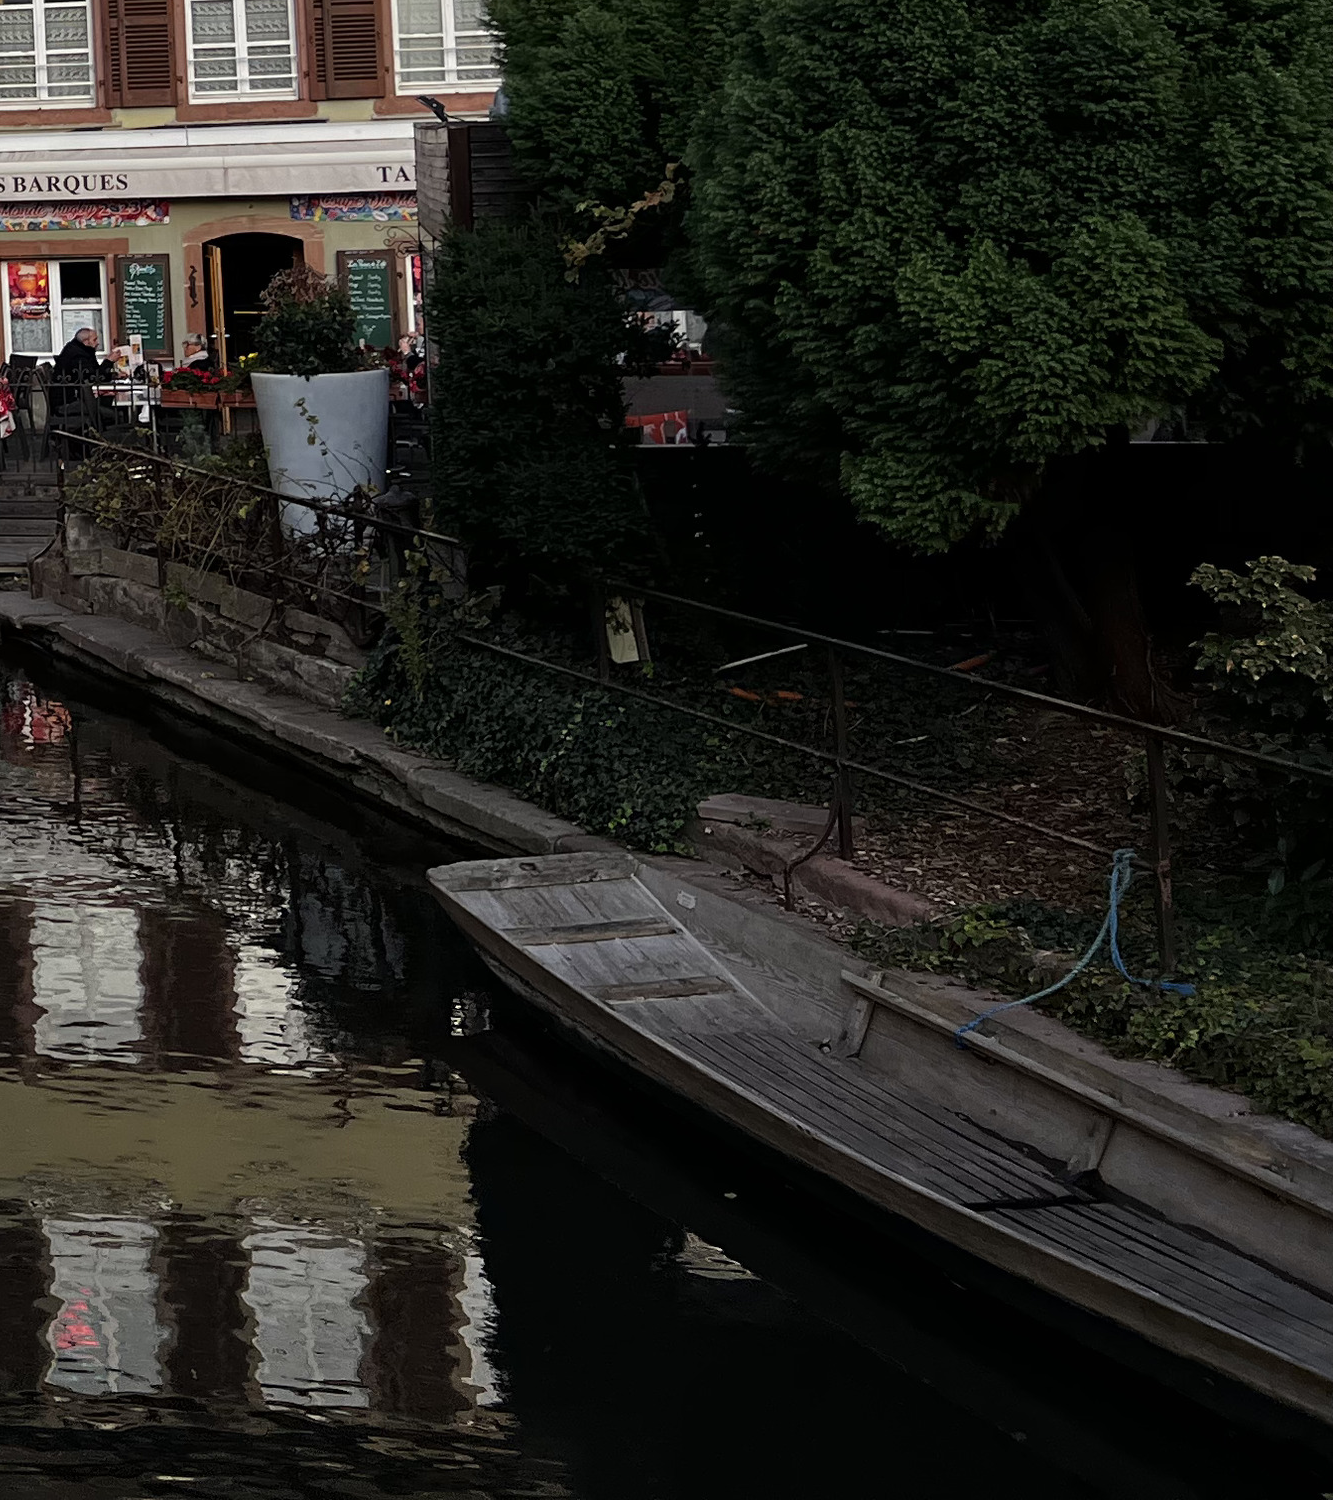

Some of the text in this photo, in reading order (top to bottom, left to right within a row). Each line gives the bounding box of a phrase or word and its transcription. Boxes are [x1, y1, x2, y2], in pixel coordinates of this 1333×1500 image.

[376, 165, 416, 183] TA
[12, 174, 128, 195] BARQUES
[0, 203, 49, 219] Monde
